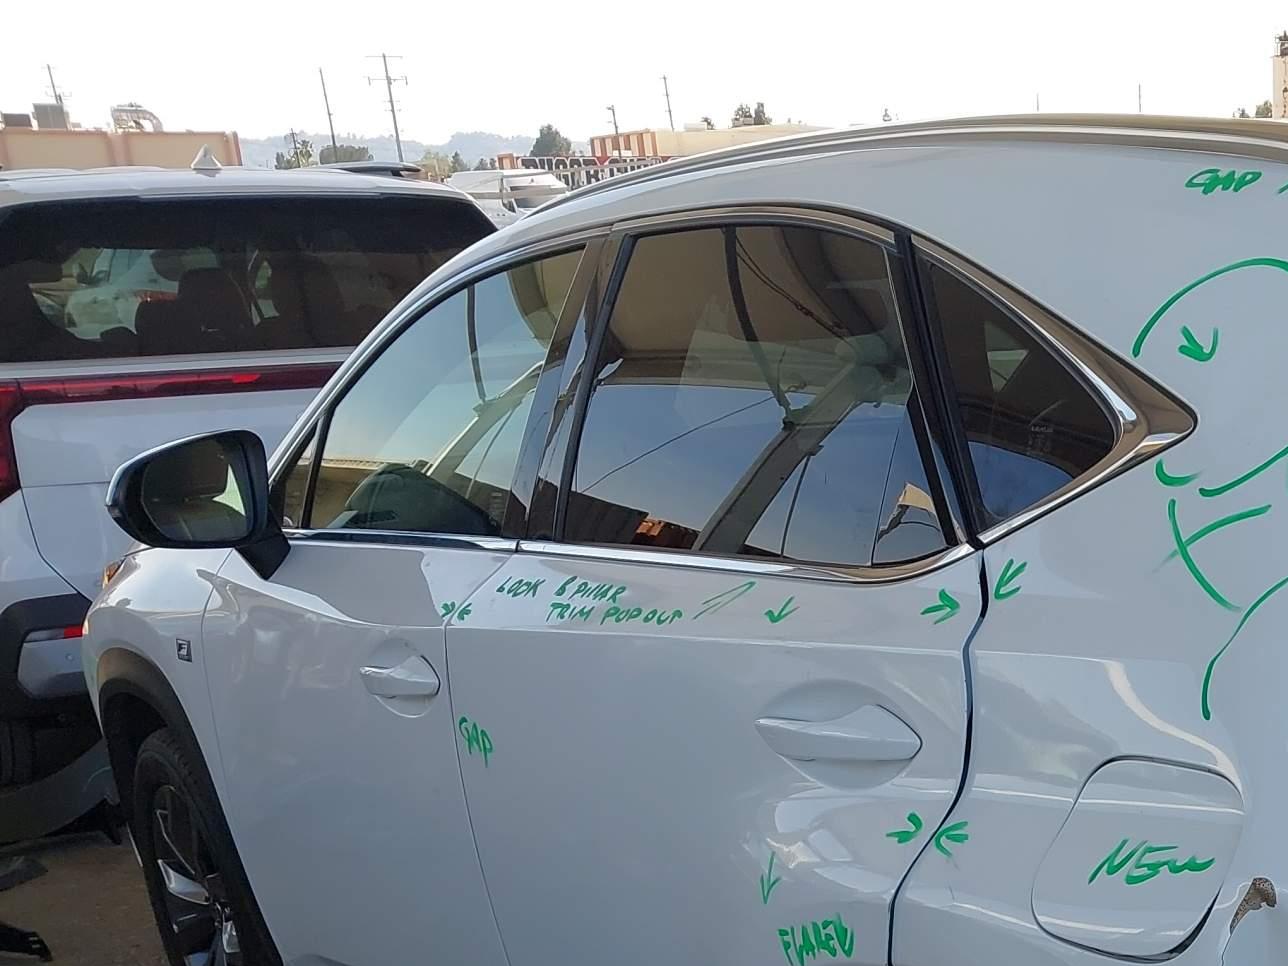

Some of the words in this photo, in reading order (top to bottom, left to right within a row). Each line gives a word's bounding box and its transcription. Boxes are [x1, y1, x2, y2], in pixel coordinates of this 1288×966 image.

[1185, 168, 1262, 194] GAP
[546, 602, 594, 623] TRIM
[459, 716, 493, 768] GAP
